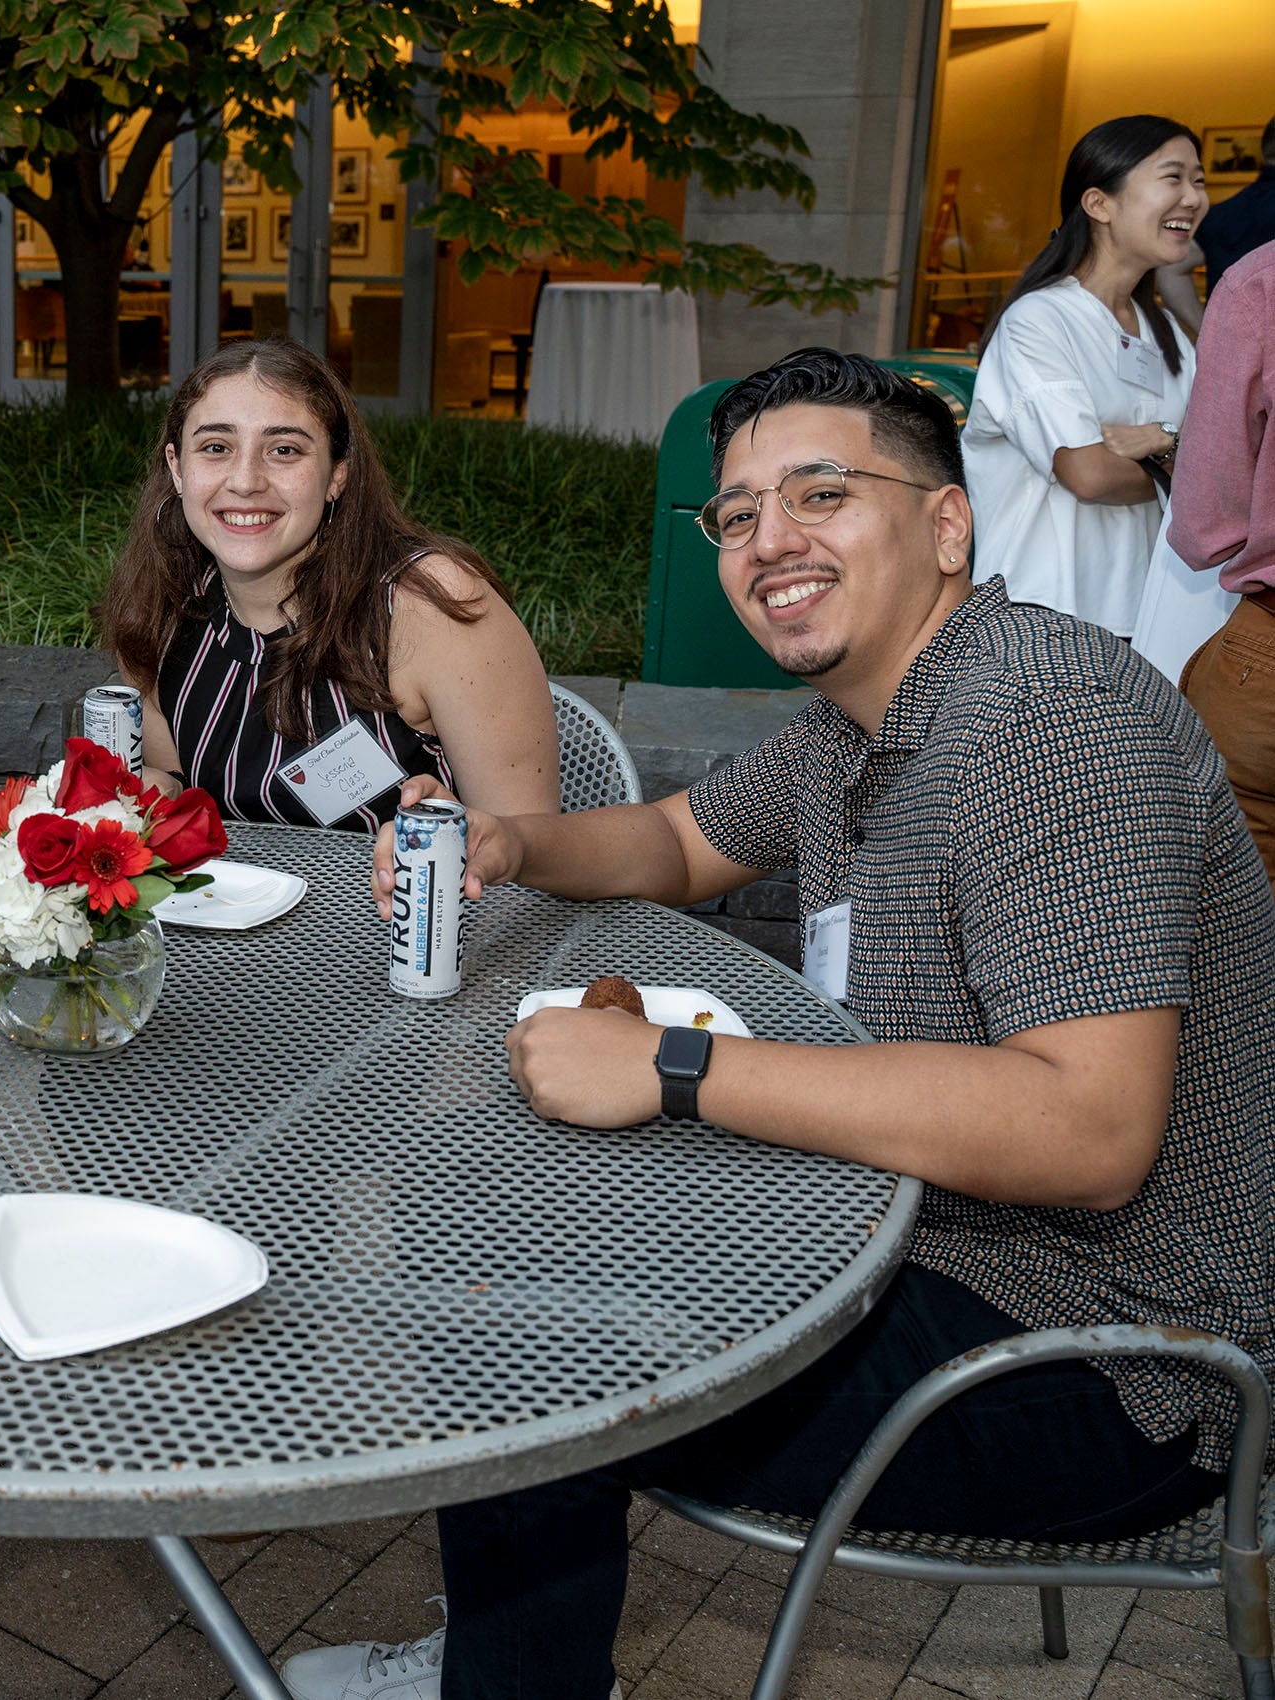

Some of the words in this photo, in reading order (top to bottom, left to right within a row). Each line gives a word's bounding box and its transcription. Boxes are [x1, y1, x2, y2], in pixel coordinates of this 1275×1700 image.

[338, 769, 366, 792] Class
[417, 865, 428, 896] ACAI
[391, 852, 412, 968] TRULY
[417, 896, 428, 906] &
[436, 888, 444, 924] SELTZER
[415, 907, 427, 972] BLUEBERRY
[435, 926, 443, 949] HARD
